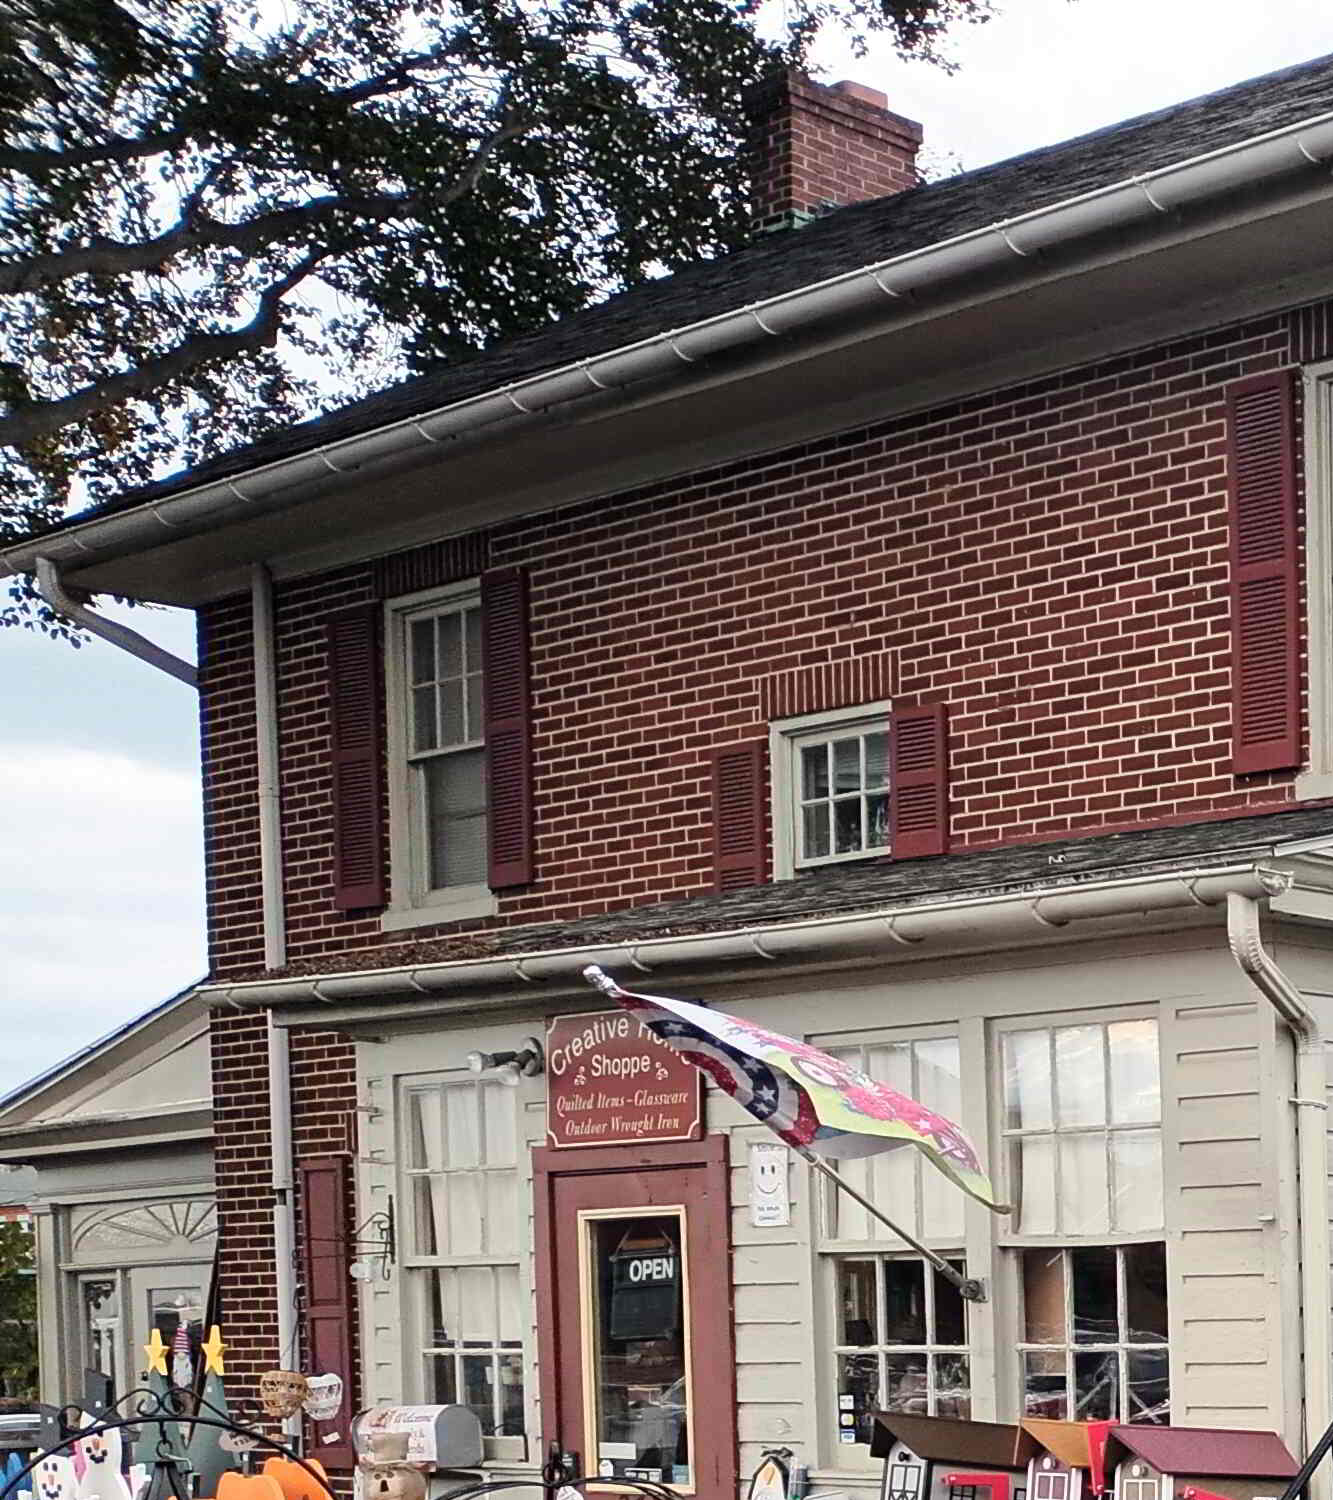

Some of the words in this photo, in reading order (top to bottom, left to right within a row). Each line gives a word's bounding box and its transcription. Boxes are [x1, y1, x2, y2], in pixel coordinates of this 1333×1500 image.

[551, 1016, 629, 1075] Creative
[591, 1054, 650, 1080] Shoppe
[556, 1092, 595, 1118] Quilted
[565, 1118, 607, 1136] Outdoor
[611, 1113, 654, 1137] Wrought
[657, 1113, 679, 1130] Iron
[629, 1257, 673, 1282] OPEN
